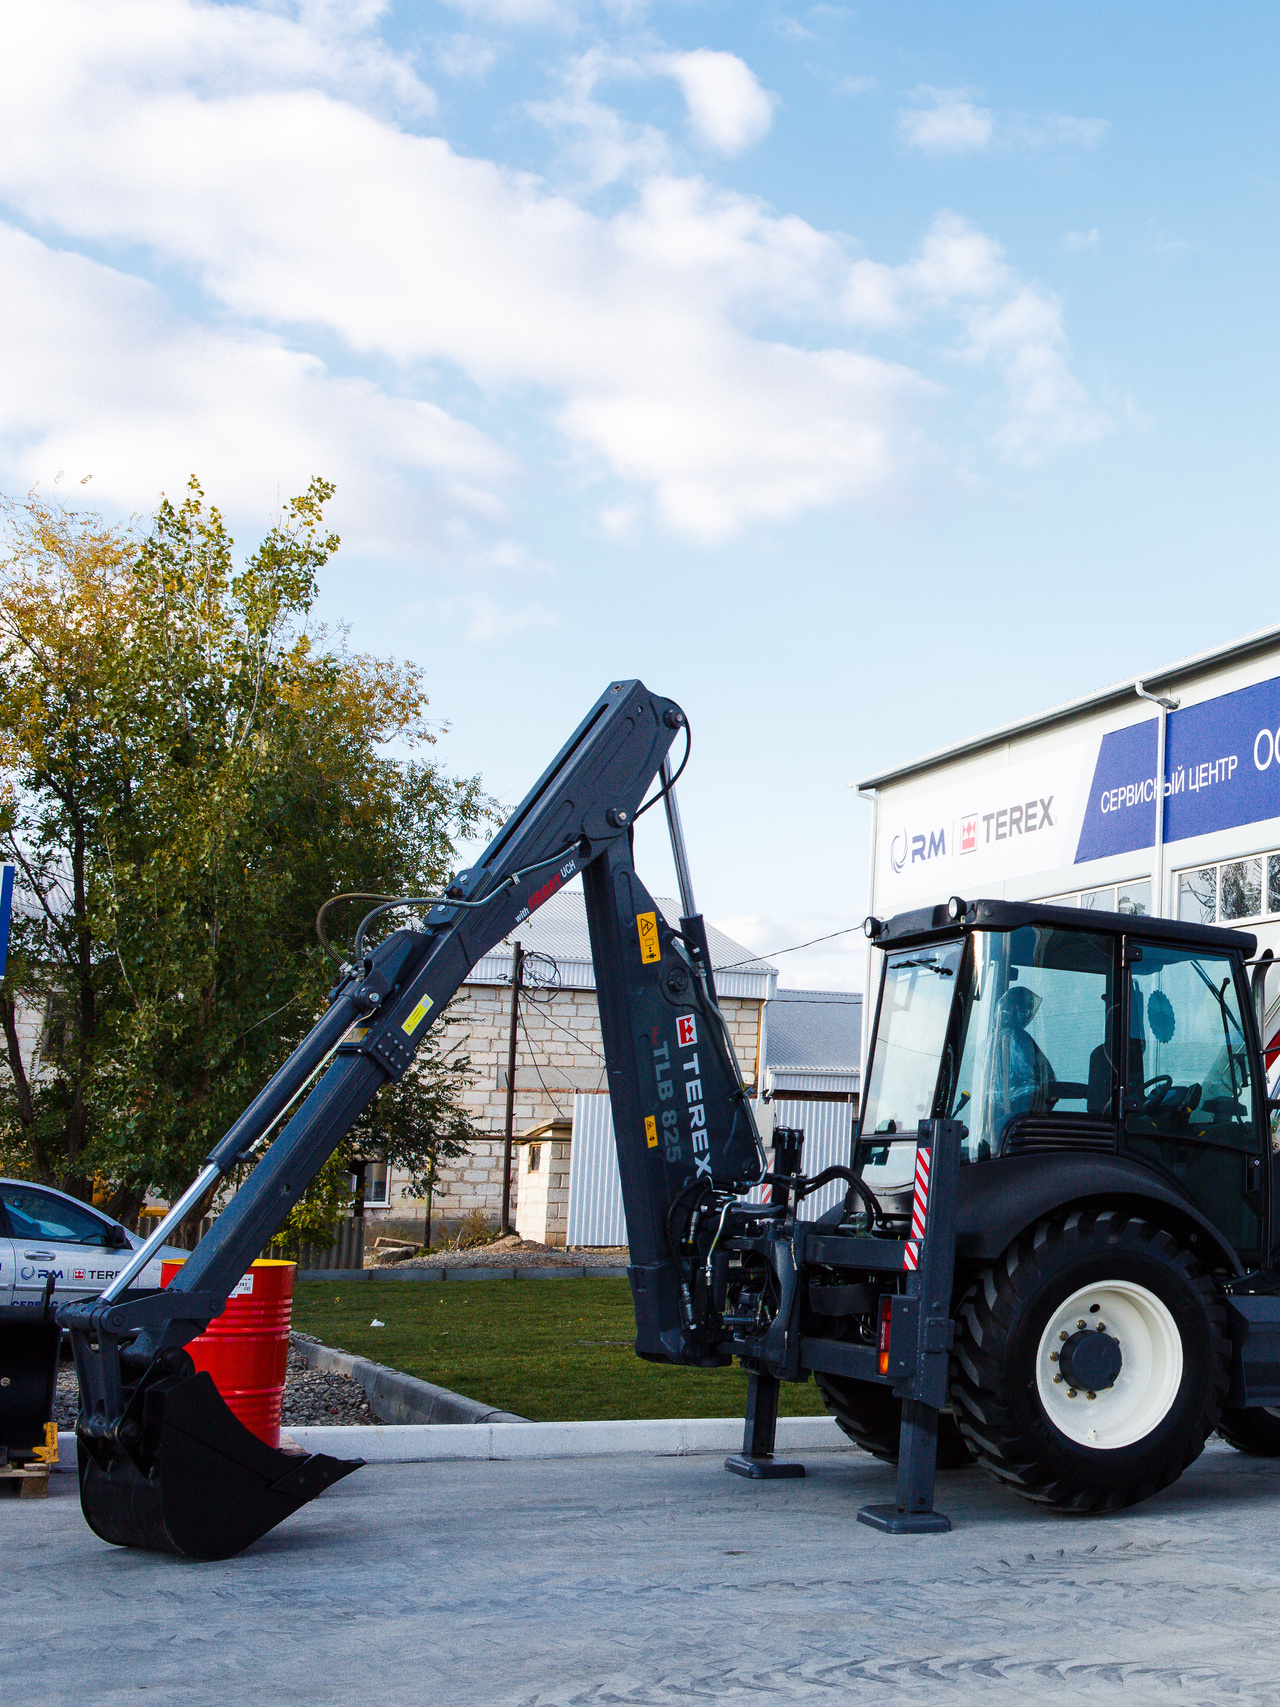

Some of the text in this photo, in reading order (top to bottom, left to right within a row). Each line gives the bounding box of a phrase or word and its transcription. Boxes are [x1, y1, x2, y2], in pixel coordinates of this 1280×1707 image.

[1188, 754, 1238, 793] ЦЕНТР
[982, 795, 1055, 844] TEREX
[911, 827, 946, 864] RM
[515, 907, 530, 923] with
[560, 859, 577, 878] UCH
[653, 1040, 683, 1164] TLB 825
[683, 1052, 713, 1180] TEREX
[37, 1269, 64, 1279] RM
[88, 1270, 121, 1280] TERE
